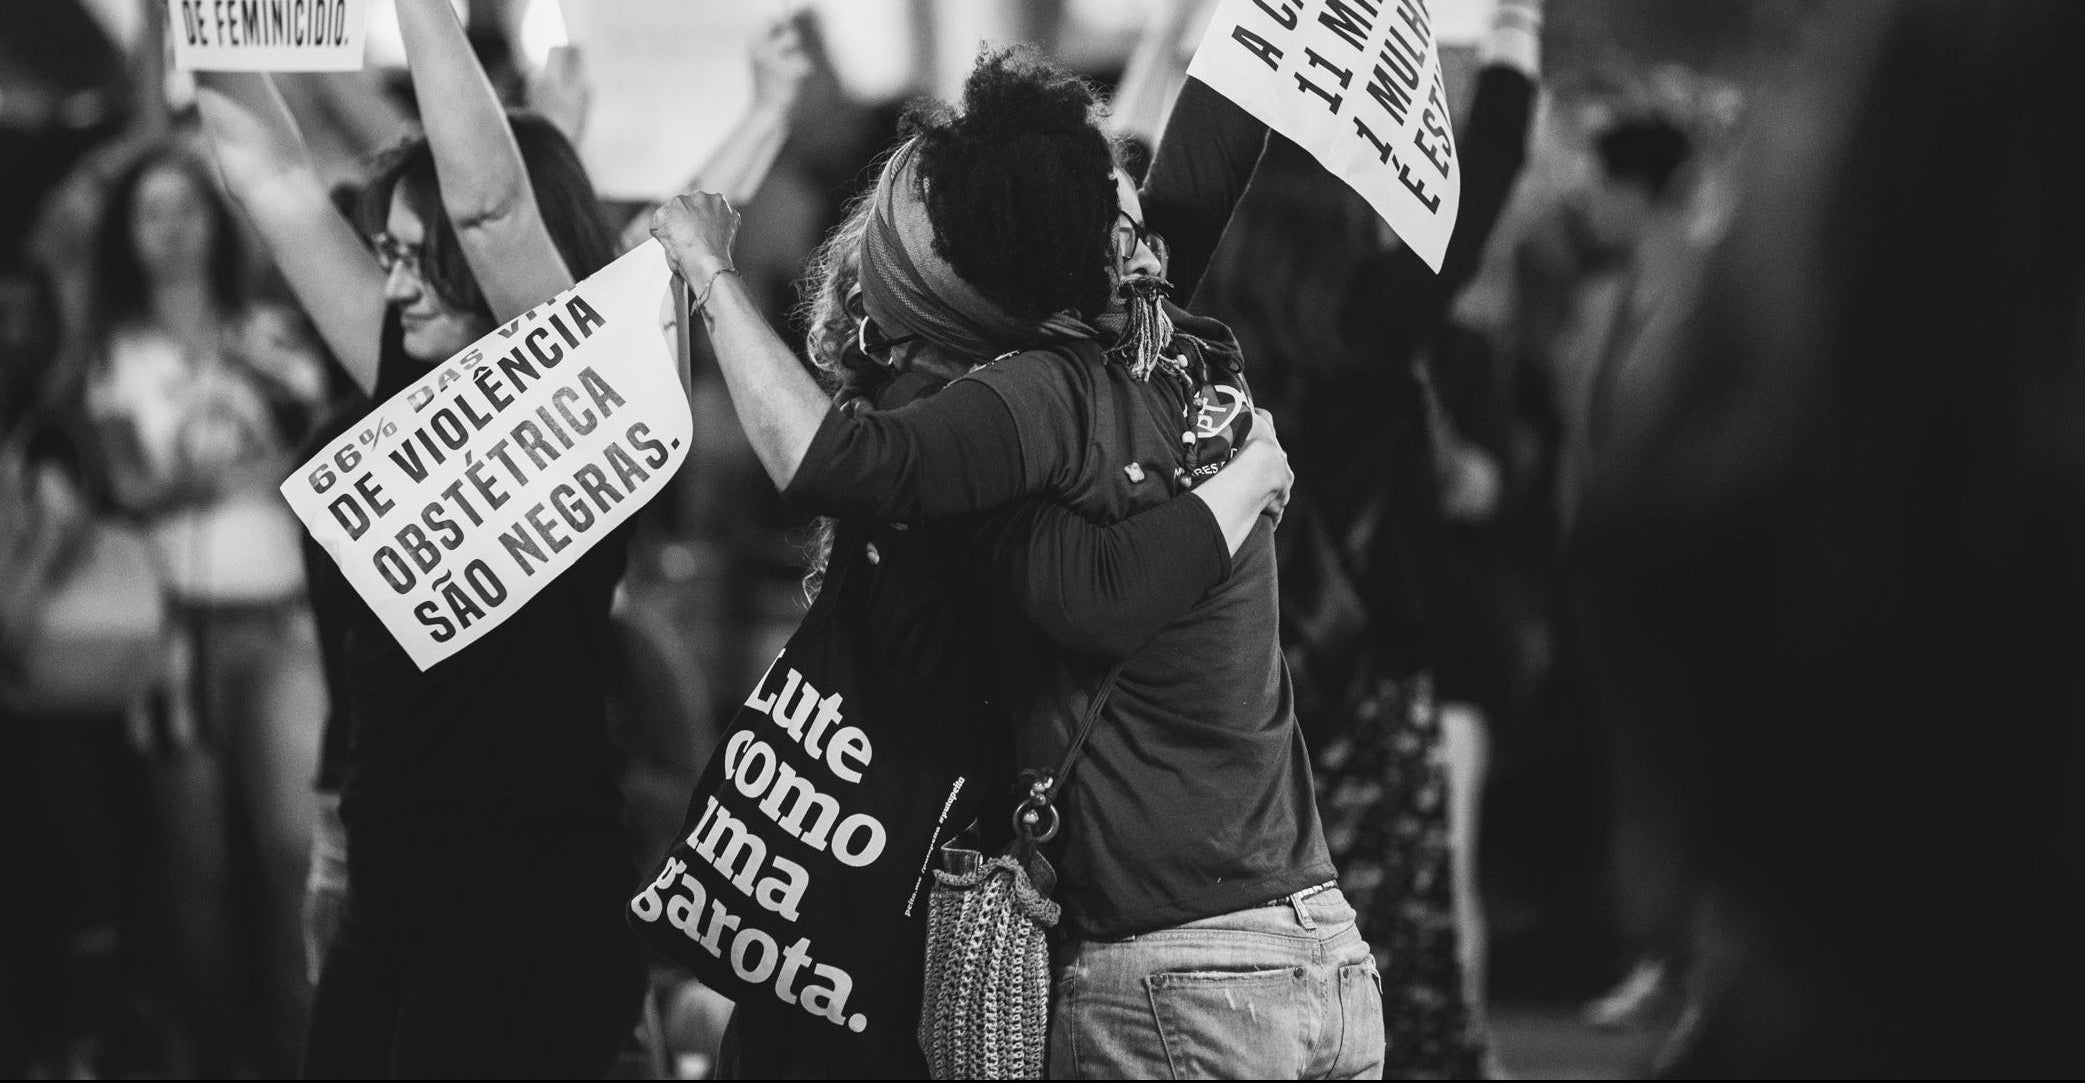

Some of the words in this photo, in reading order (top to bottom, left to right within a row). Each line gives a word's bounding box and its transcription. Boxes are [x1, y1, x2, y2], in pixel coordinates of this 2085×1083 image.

[182, 0, 208, 46] DE
[1231, 24, 1284, 72] A
[1294, 46, 1354, 115] 11
[1353, 116, 1393, 165] 1
[1391, 153, 1441, 215] É
[1414, 64, 1452, 180] EST
[308, 416, 398, 494] 66%
[406, 348, 484, 413] DAS
[327, 471, 396, 542] DE
[388, 294, 607, 485] VIOLÊNCIA
[372, 366, 627, 595] OBSTÉTRICA
[413, 558, 509, 643] SÃO
[498, 421, 681, 577] NEGRAS.
[744, 648, 873, 784] Lute
[724, 729, 888, 867] como
[630, 855, 868, 1033] garota.
